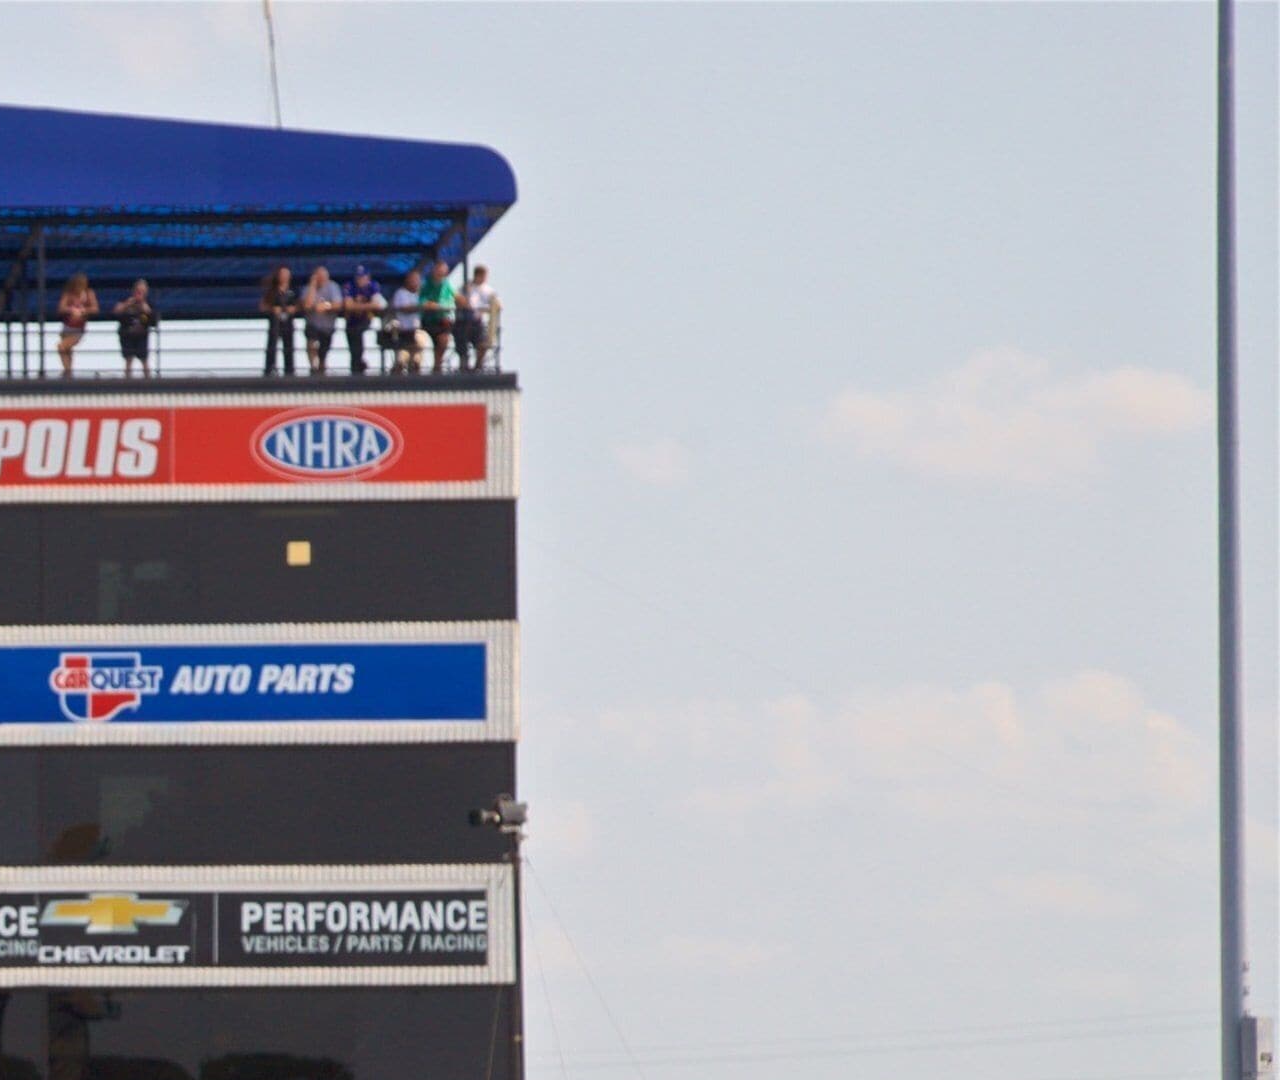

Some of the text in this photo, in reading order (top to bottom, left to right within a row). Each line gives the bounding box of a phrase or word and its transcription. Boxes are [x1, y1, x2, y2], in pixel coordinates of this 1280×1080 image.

[272, 420, 385, 471] NHRA
[171, 663, 355, 694] AUTO PARTS
[242, 901, 488, 933] PERFORMANCE
[38, 946, 189, 963] CHEVROLET
[243, 935, 331, 954] VEHICLES
[346, 934, 404, 952] PARTS
[420, 933, 488, 952] RACING
